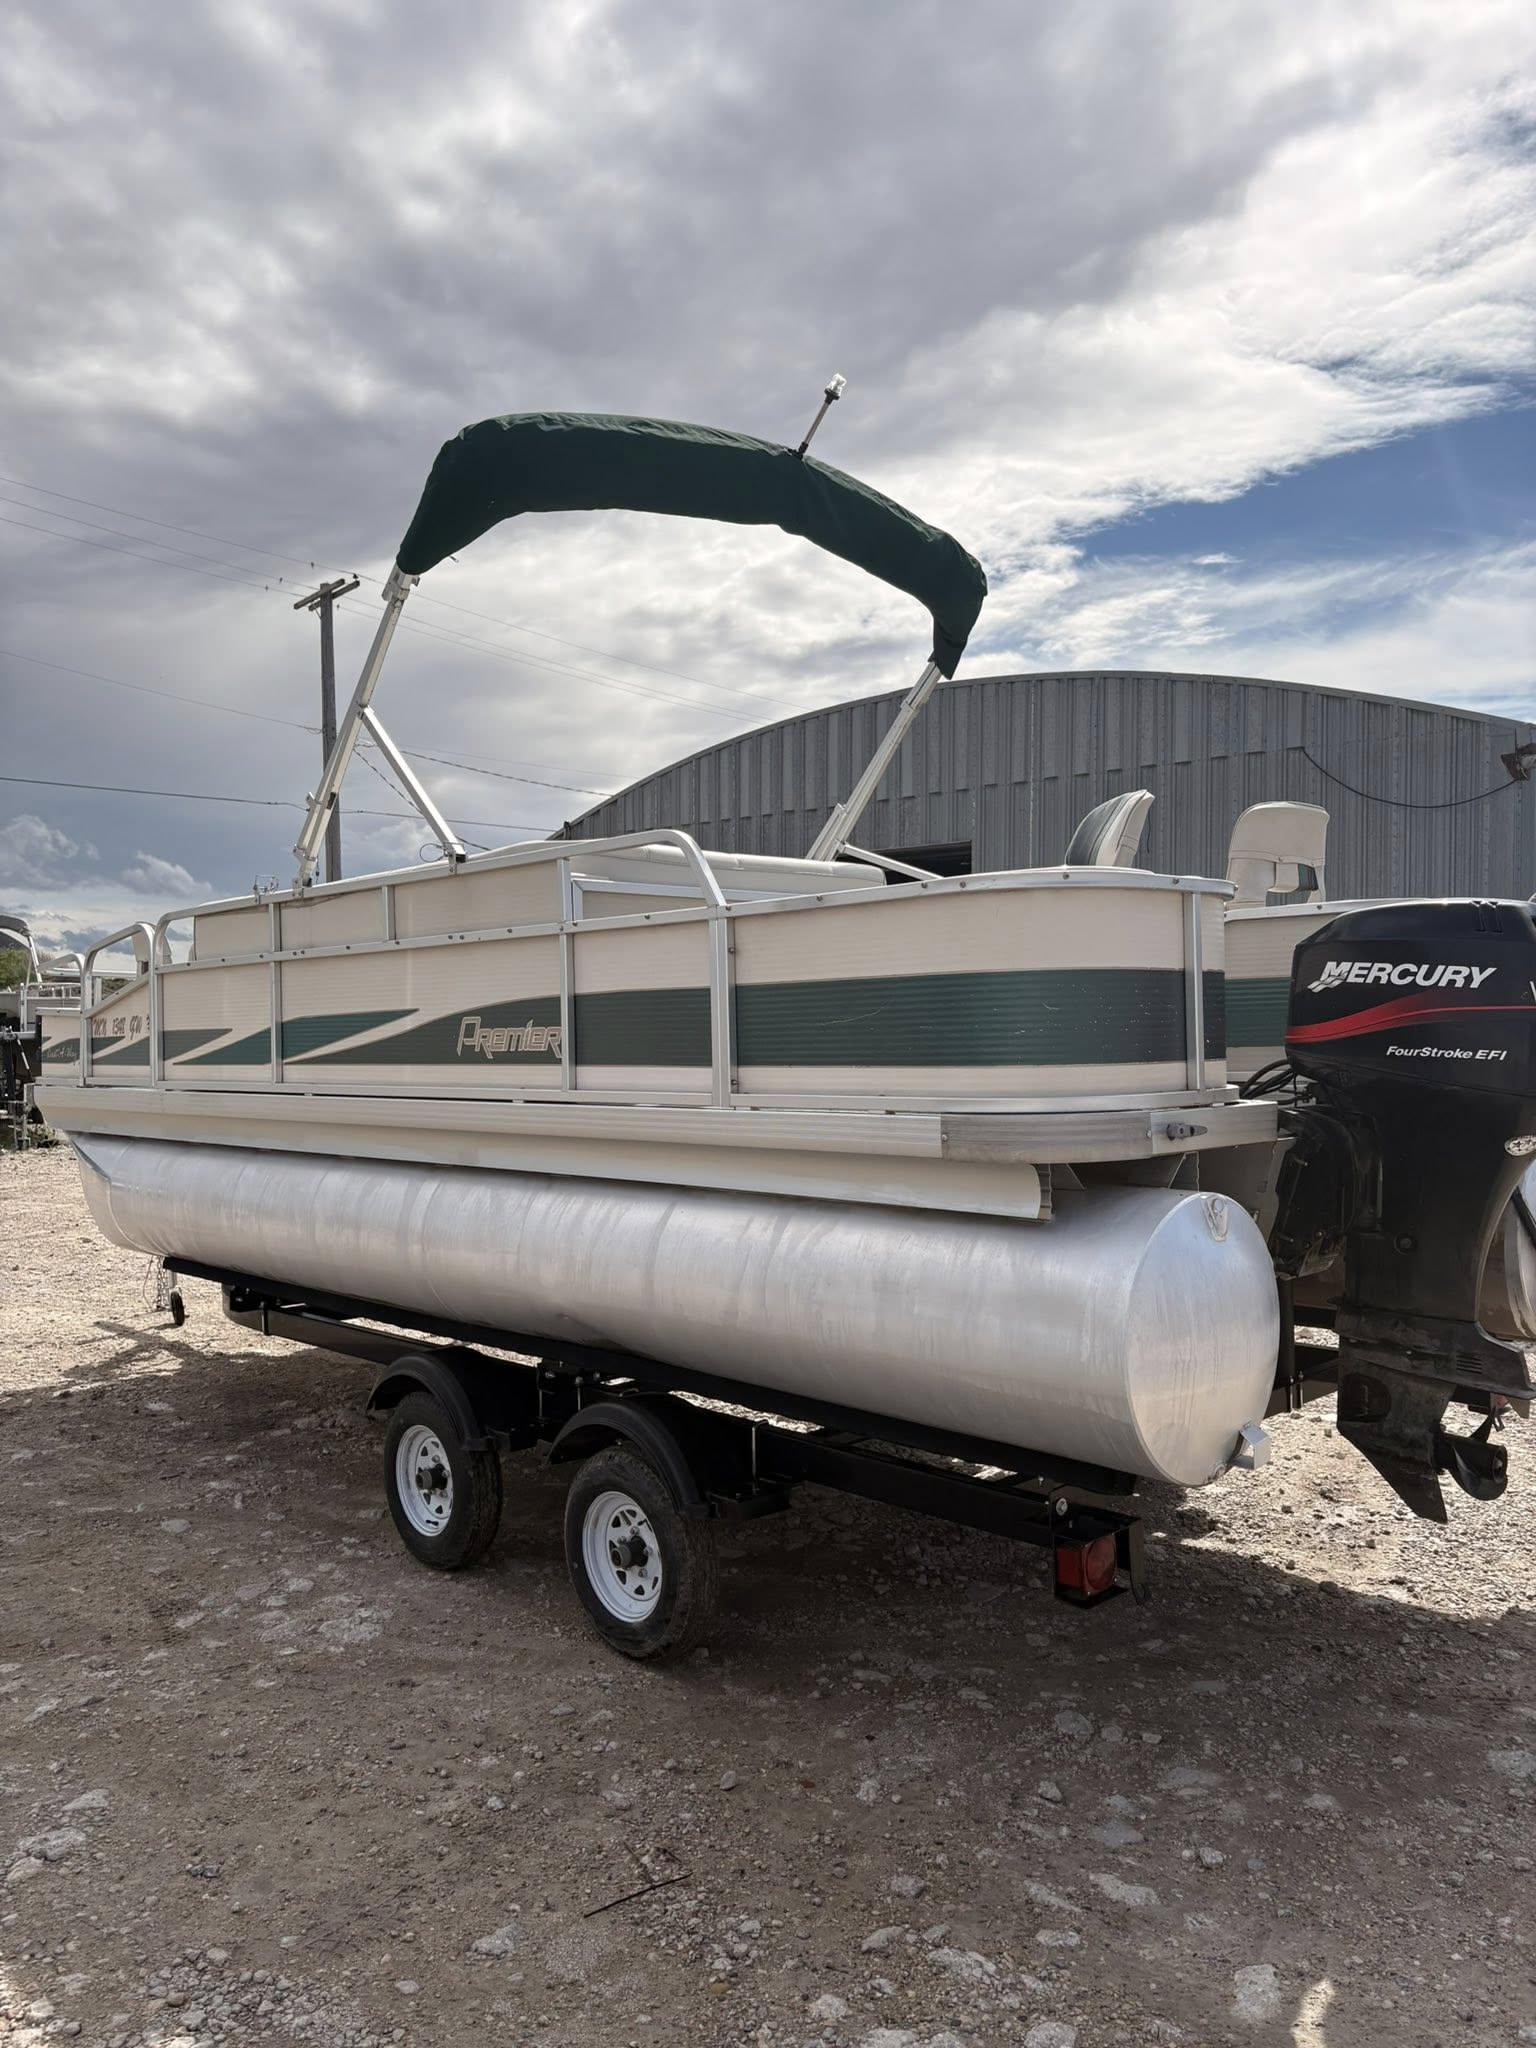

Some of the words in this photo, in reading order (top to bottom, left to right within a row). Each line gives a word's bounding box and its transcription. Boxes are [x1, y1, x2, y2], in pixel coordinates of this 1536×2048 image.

[1307, 961, 1498, 993] MERCURY
[1385, 1045, 1473, 1060] FourStroke
[1475, 1049, 1508, 1061] EFI
